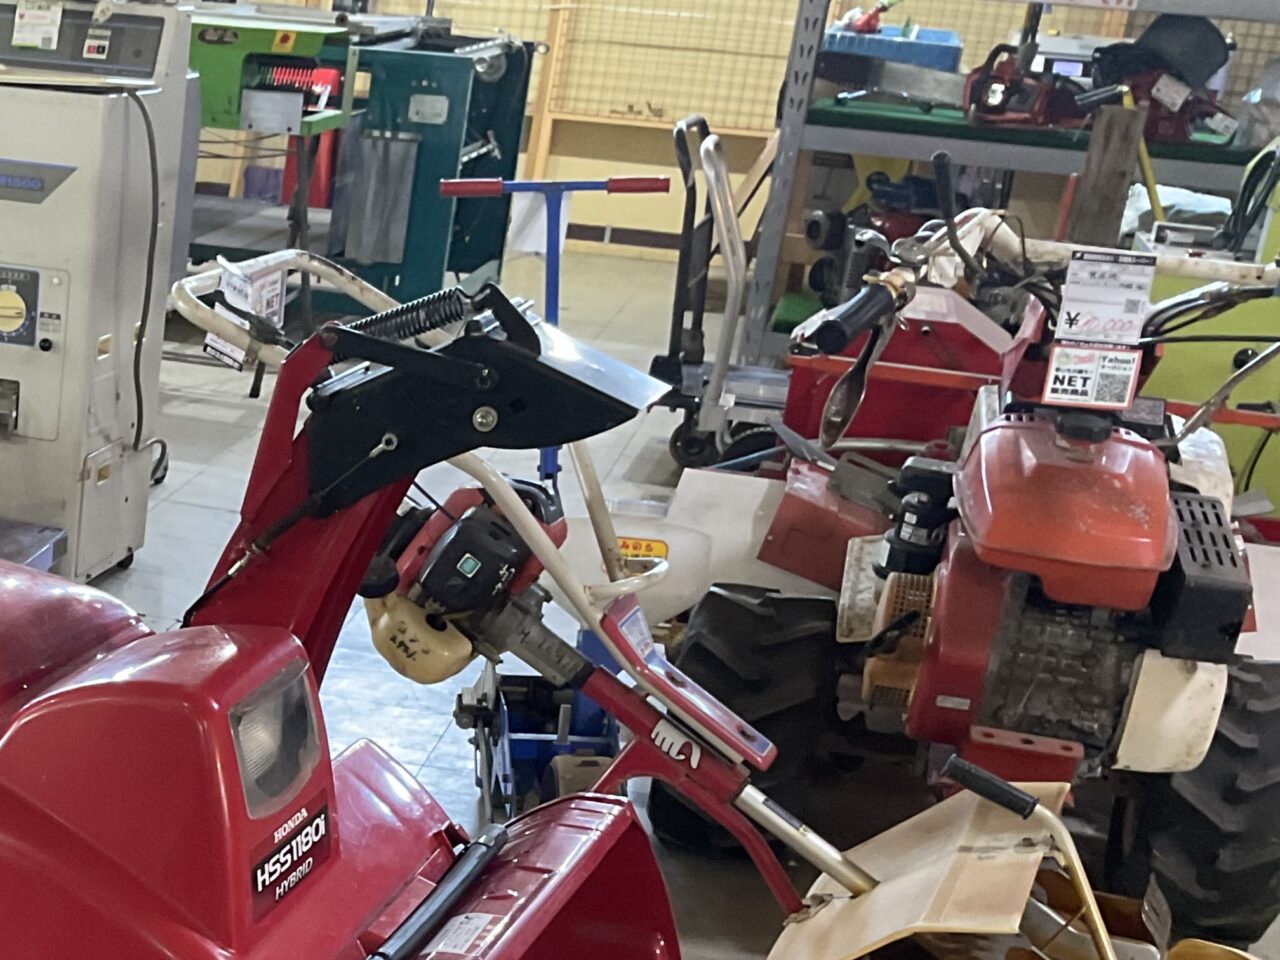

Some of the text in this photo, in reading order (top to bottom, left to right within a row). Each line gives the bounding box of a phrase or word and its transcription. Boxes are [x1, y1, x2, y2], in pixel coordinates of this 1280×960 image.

[1102, 355, 1135, 365] Yahoo!
[1052, 374, 1091, 388] NET
[273, 807, 308, 844] HONDA
[256, 813, 326, 892] HSS1180i
[275, 857, 313, 901] HYBRID
